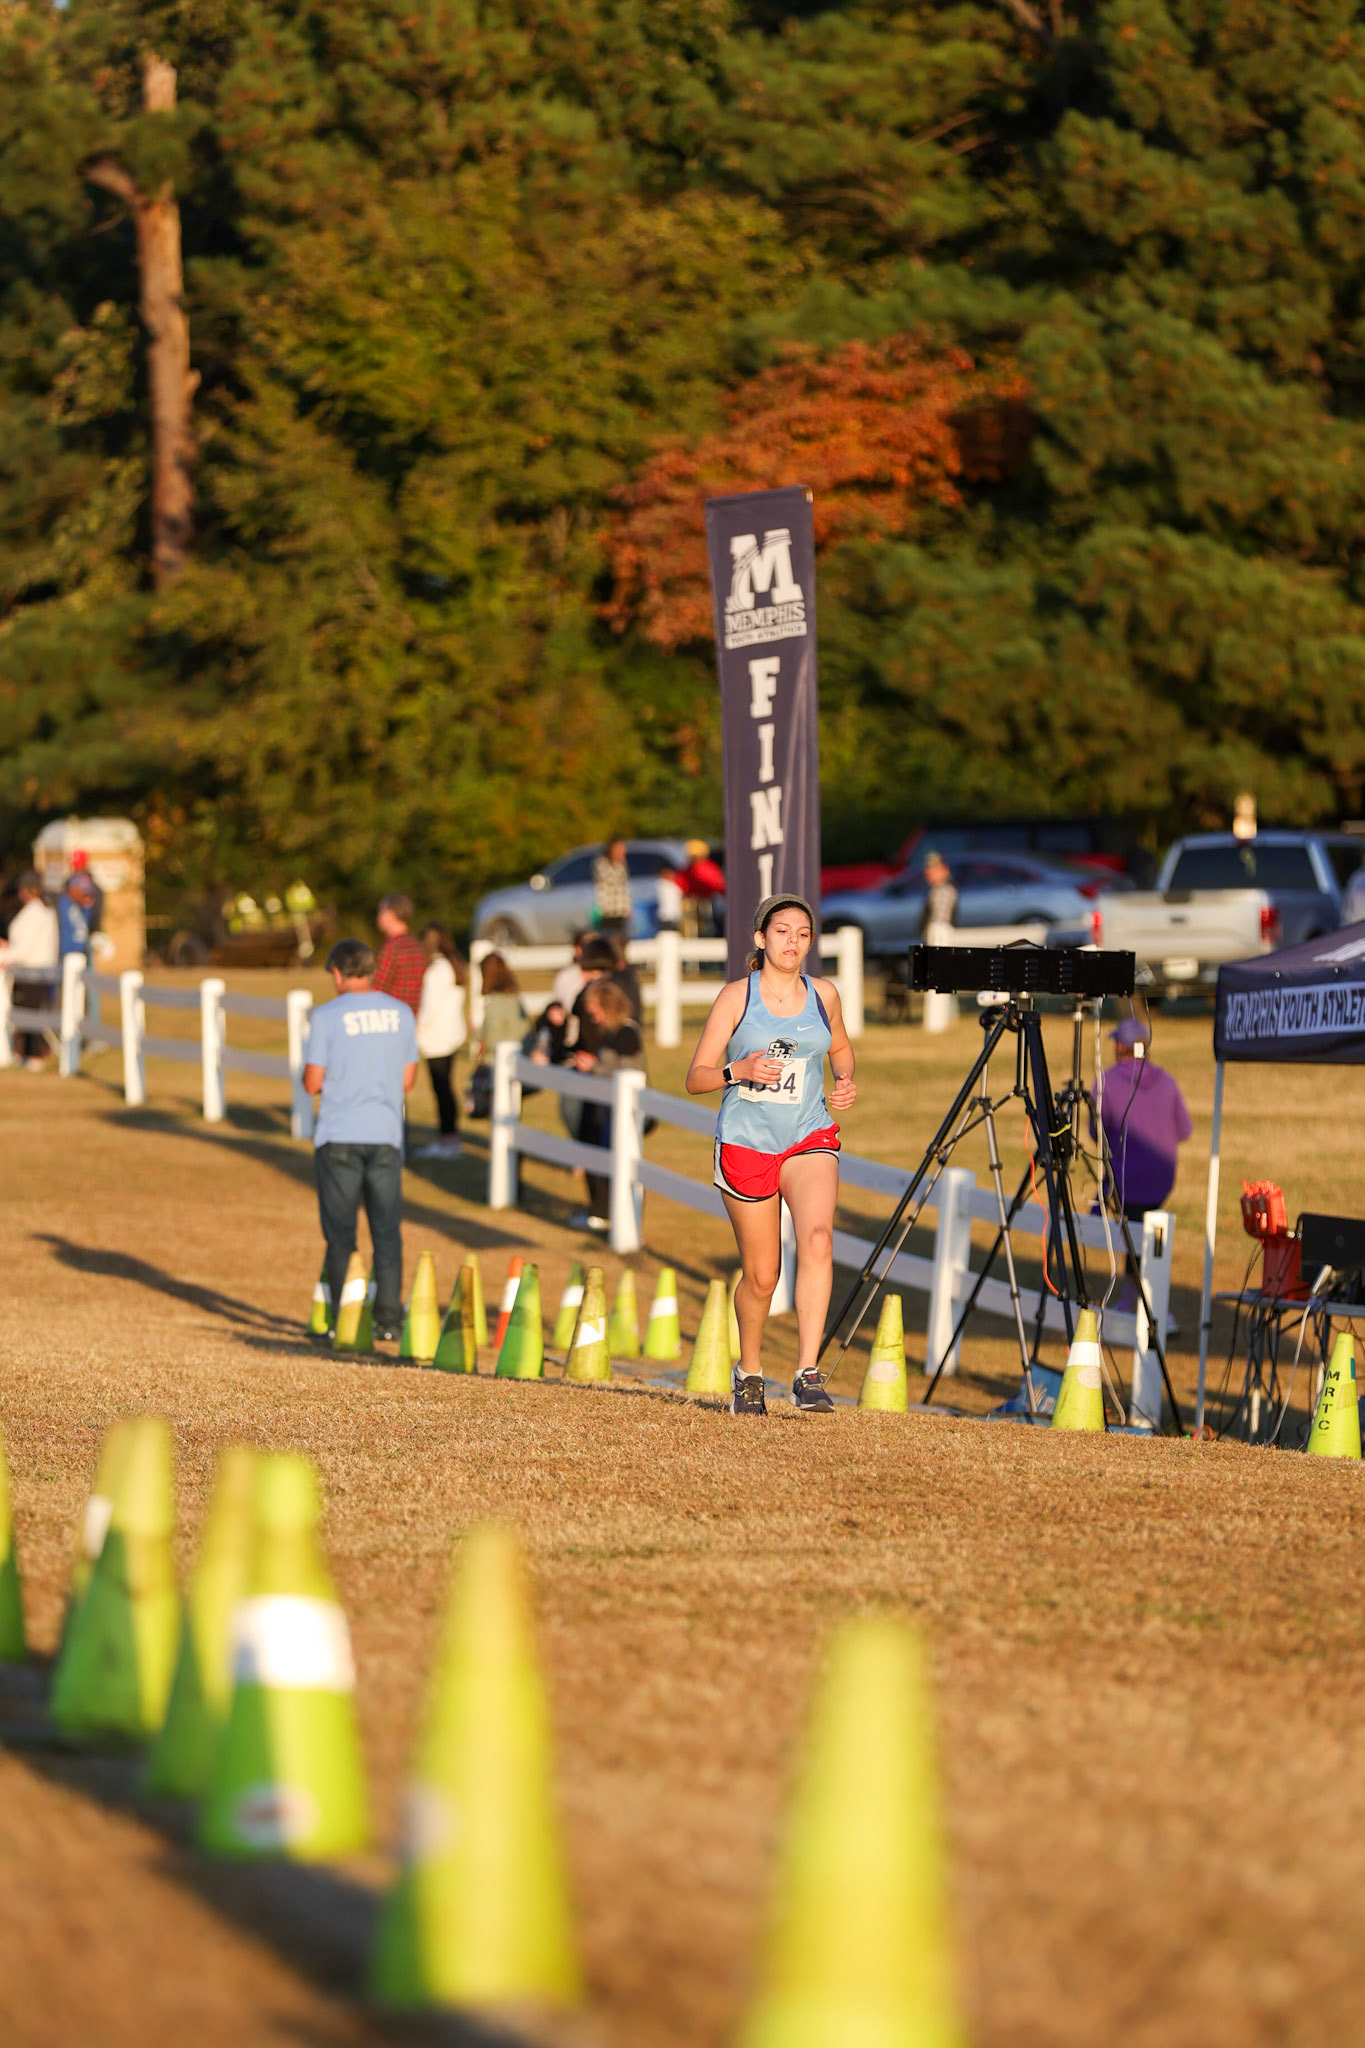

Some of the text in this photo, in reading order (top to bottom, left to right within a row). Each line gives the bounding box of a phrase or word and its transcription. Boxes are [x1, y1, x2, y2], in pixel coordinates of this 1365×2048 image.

[724, 527, 804, 614] M
[724, 601, 806, 634] MEMPHIS
[343, 1008, 400, 1036] STAFF
[1225, 989, 1282, 1041] MEMPHIS
[1282, 991, 1319, 1031] YOUTH
